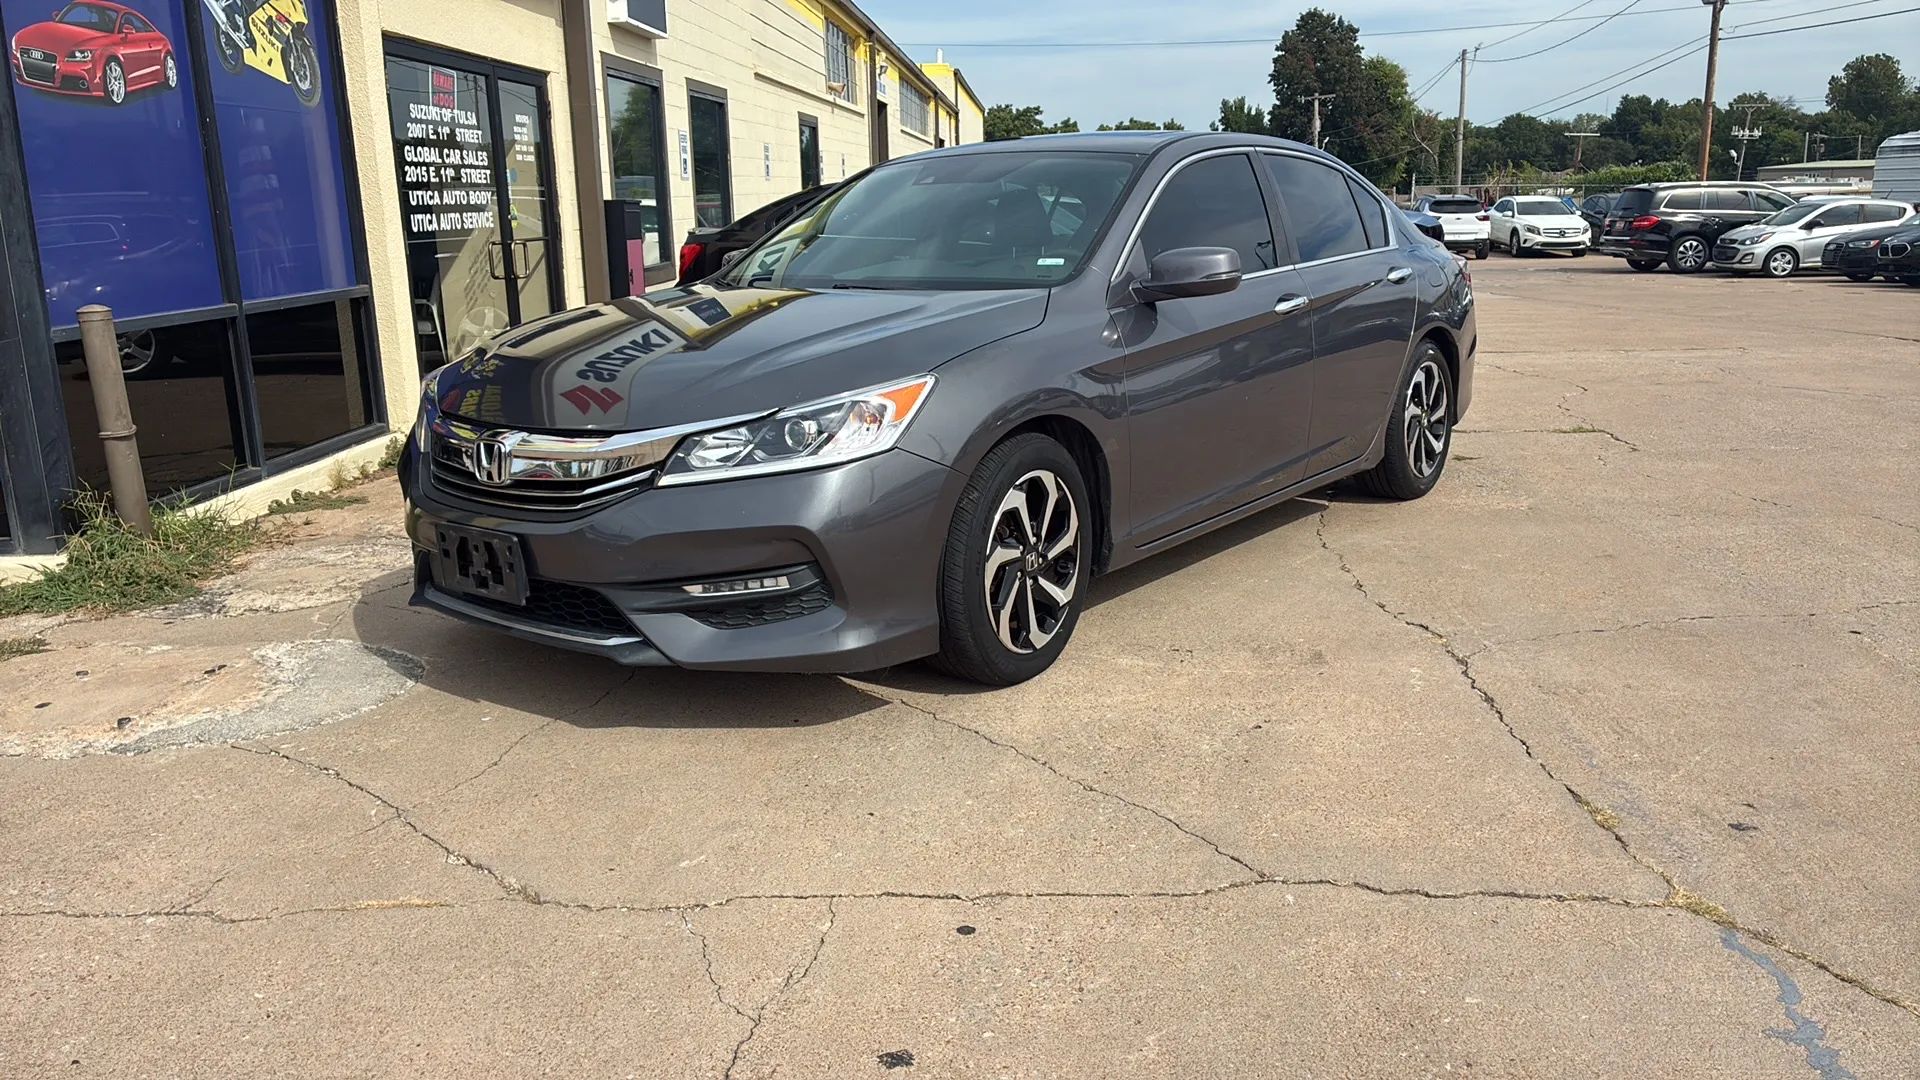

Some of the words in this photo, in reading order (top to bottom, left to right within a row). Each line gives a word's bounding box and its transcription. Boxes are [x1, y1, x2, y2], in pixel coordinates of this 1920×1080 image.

[251, 16, 279, 52] SUZUKI
[409, 103, 440, 121] SUZUKI
[442, 107, 453, 122] OF
[453, 109, 477, 126] TULSA
[407, 122, 426, 138] 2007
[428, 125, 437, 139] E.
[455, 128, 482, 143] STREET
[404, 145, 442, 163] GLOBAL
[443, 148, 462, 164] CAR
[463, 149, 488, 166] SALES
[404, 165, 428, 182] 2015
[429, 166, 439, 182] E.
[461, 168, 490, 184] STREET
[409, 190, 441, 206] UTICA
[443, 190, 467, 205] AUTO
[469, 190, 492, 205] BODY
[410, 213, 439, 232] UTICA
[440, 212, 461, 230] AUTO
[462, 211, 494, 229] SERVICE
